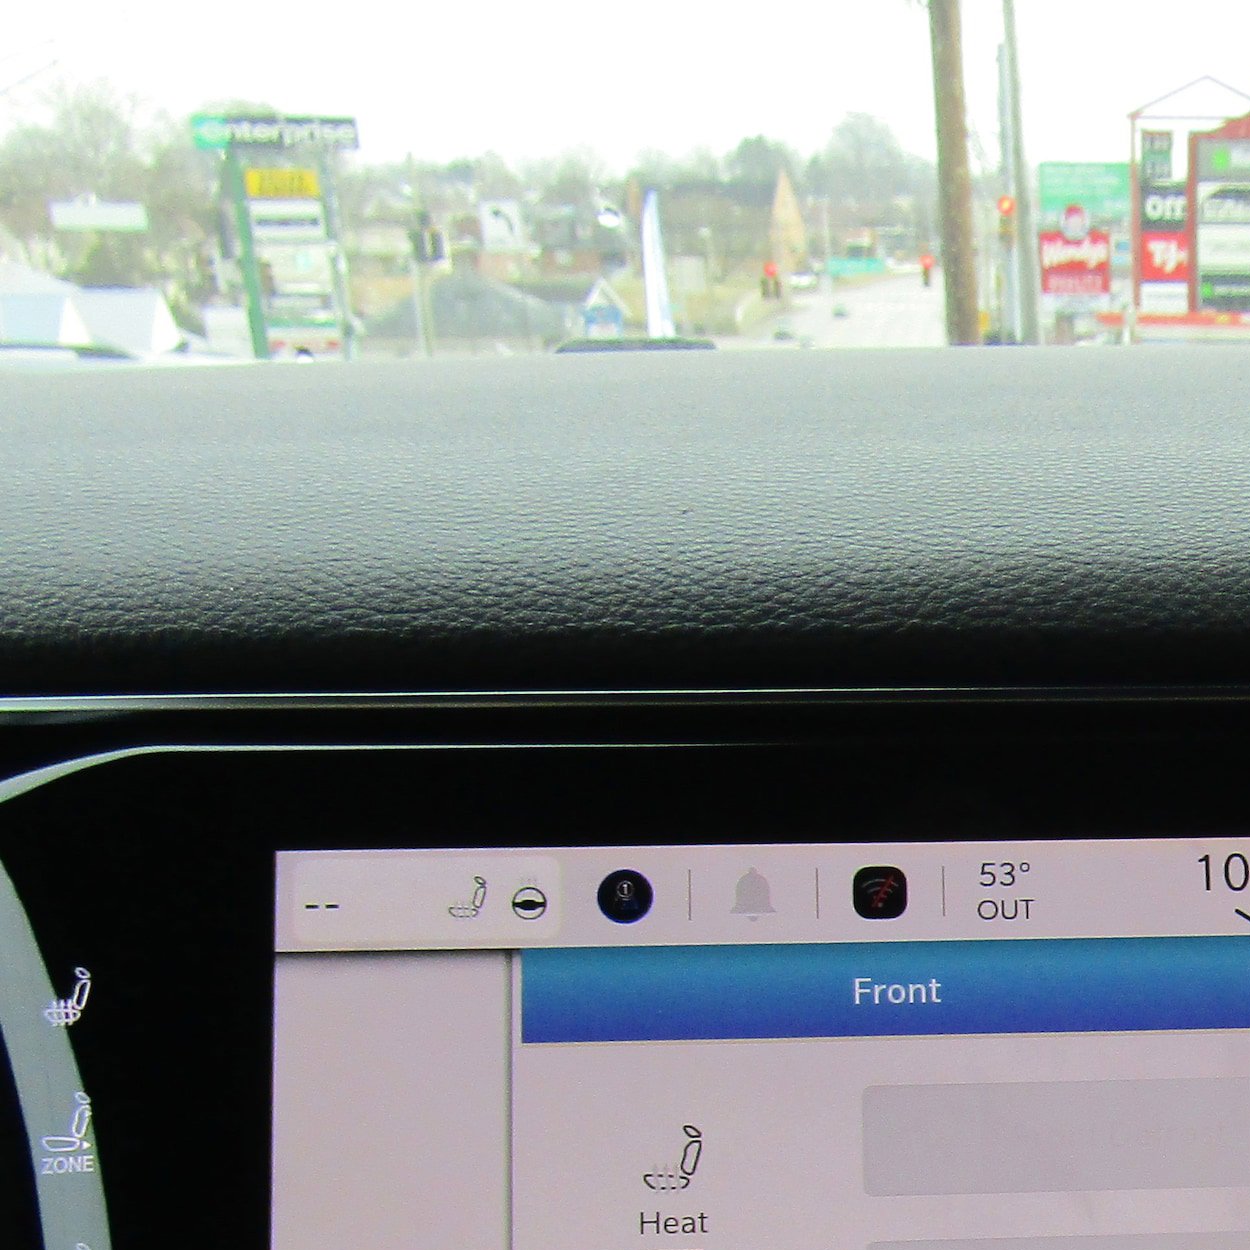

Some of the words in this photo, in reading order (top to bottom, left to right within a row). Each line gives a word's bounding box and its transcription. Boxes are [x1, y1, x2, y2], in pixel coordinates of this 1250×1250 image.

[979, 861, 1031, 888] 53°
[976, 898, 1035, 921] OUT
[853, 977, 942, 1005] Front
[40, 1155, 95, 1176] ZONE
[639, 1211, 708, 1235] Heat
